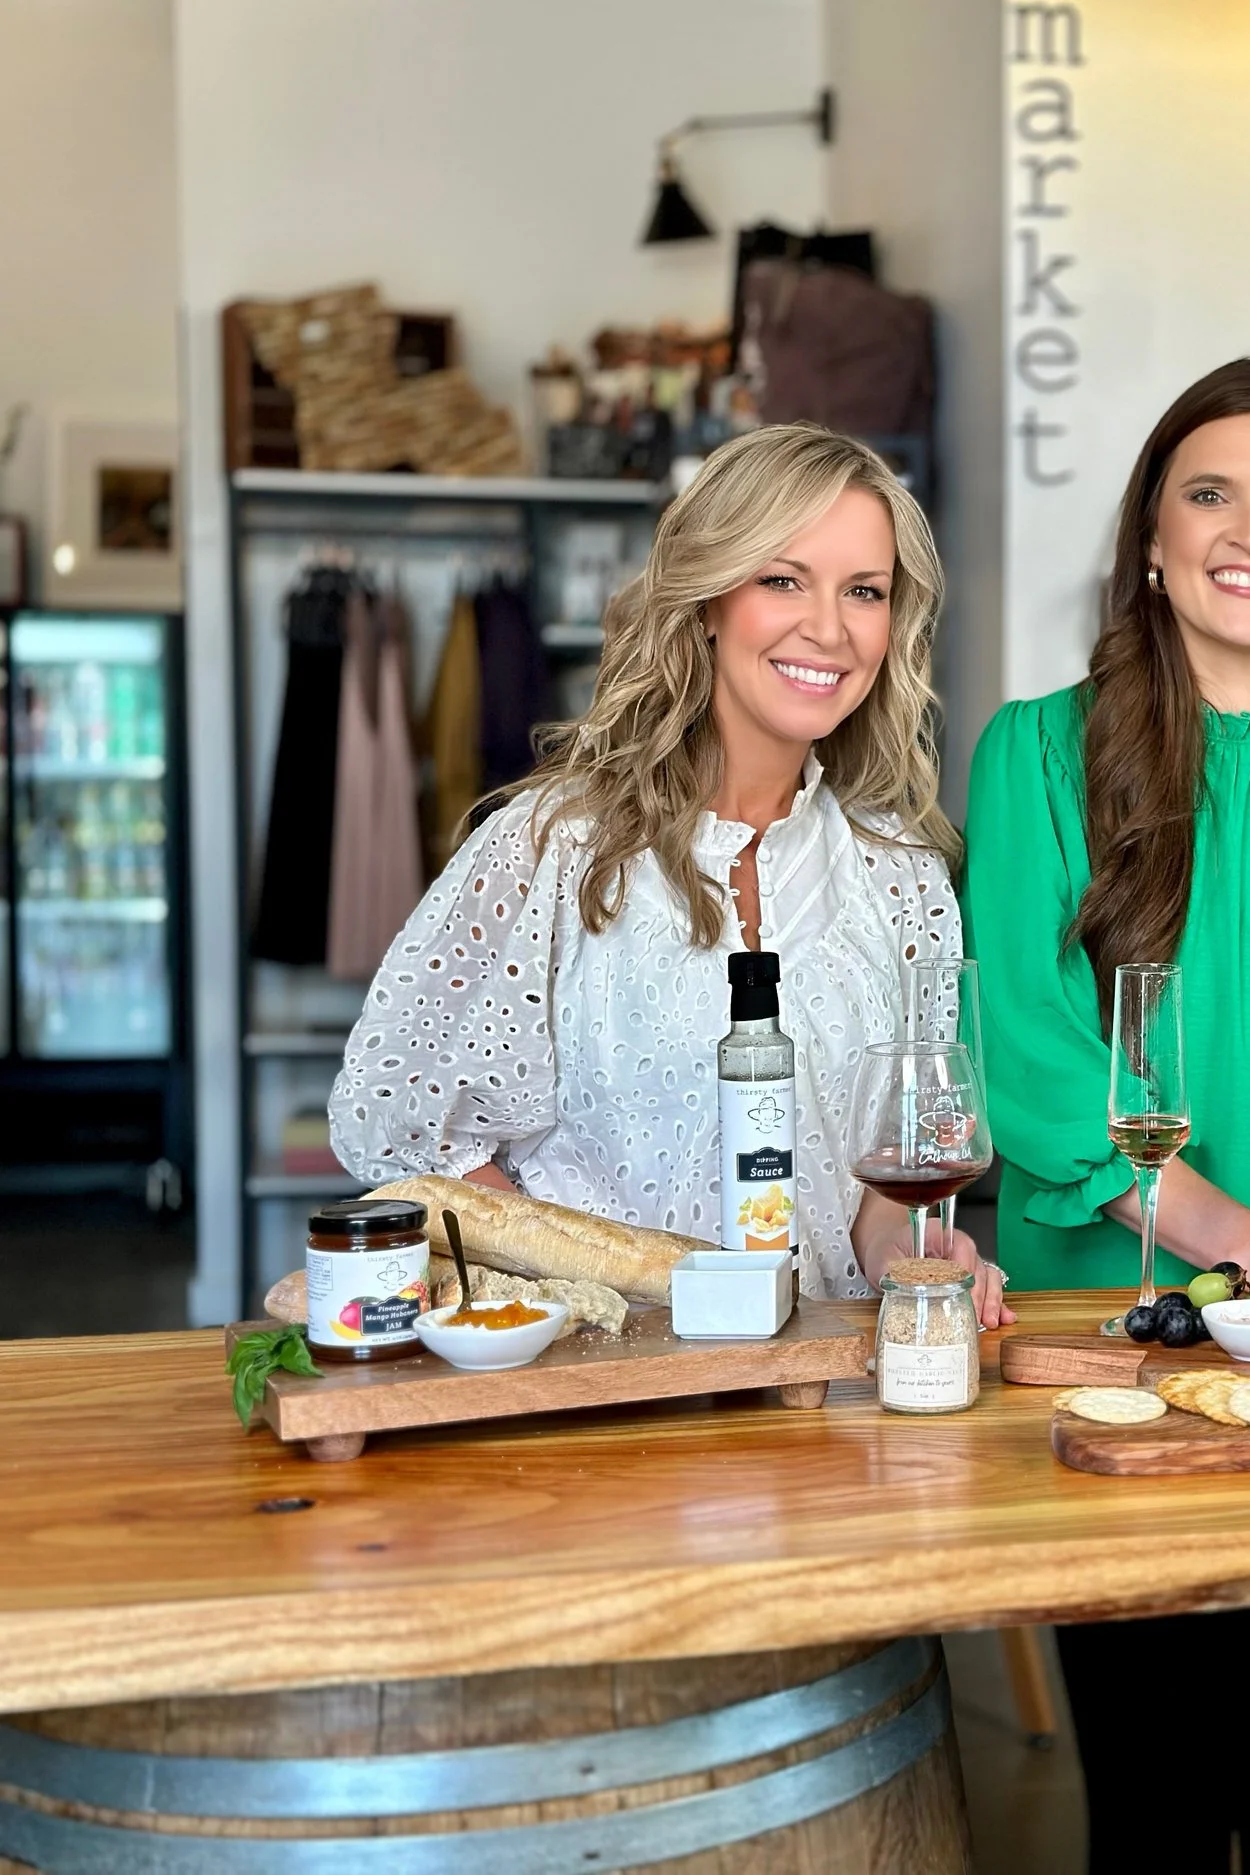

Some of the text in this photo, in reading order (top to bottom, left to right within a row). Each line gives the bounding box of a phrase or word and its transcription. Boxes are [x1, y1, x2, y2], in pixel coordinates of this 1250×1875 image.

[1010, 2, 1087, 488] market
[736, 1088, 768, 1096] thirsty
[750, 1167, 783, 1177] Sauce
[377, 1303, 409, 1313] Pineapple
[385, 1321, 402, 1331] JAM
